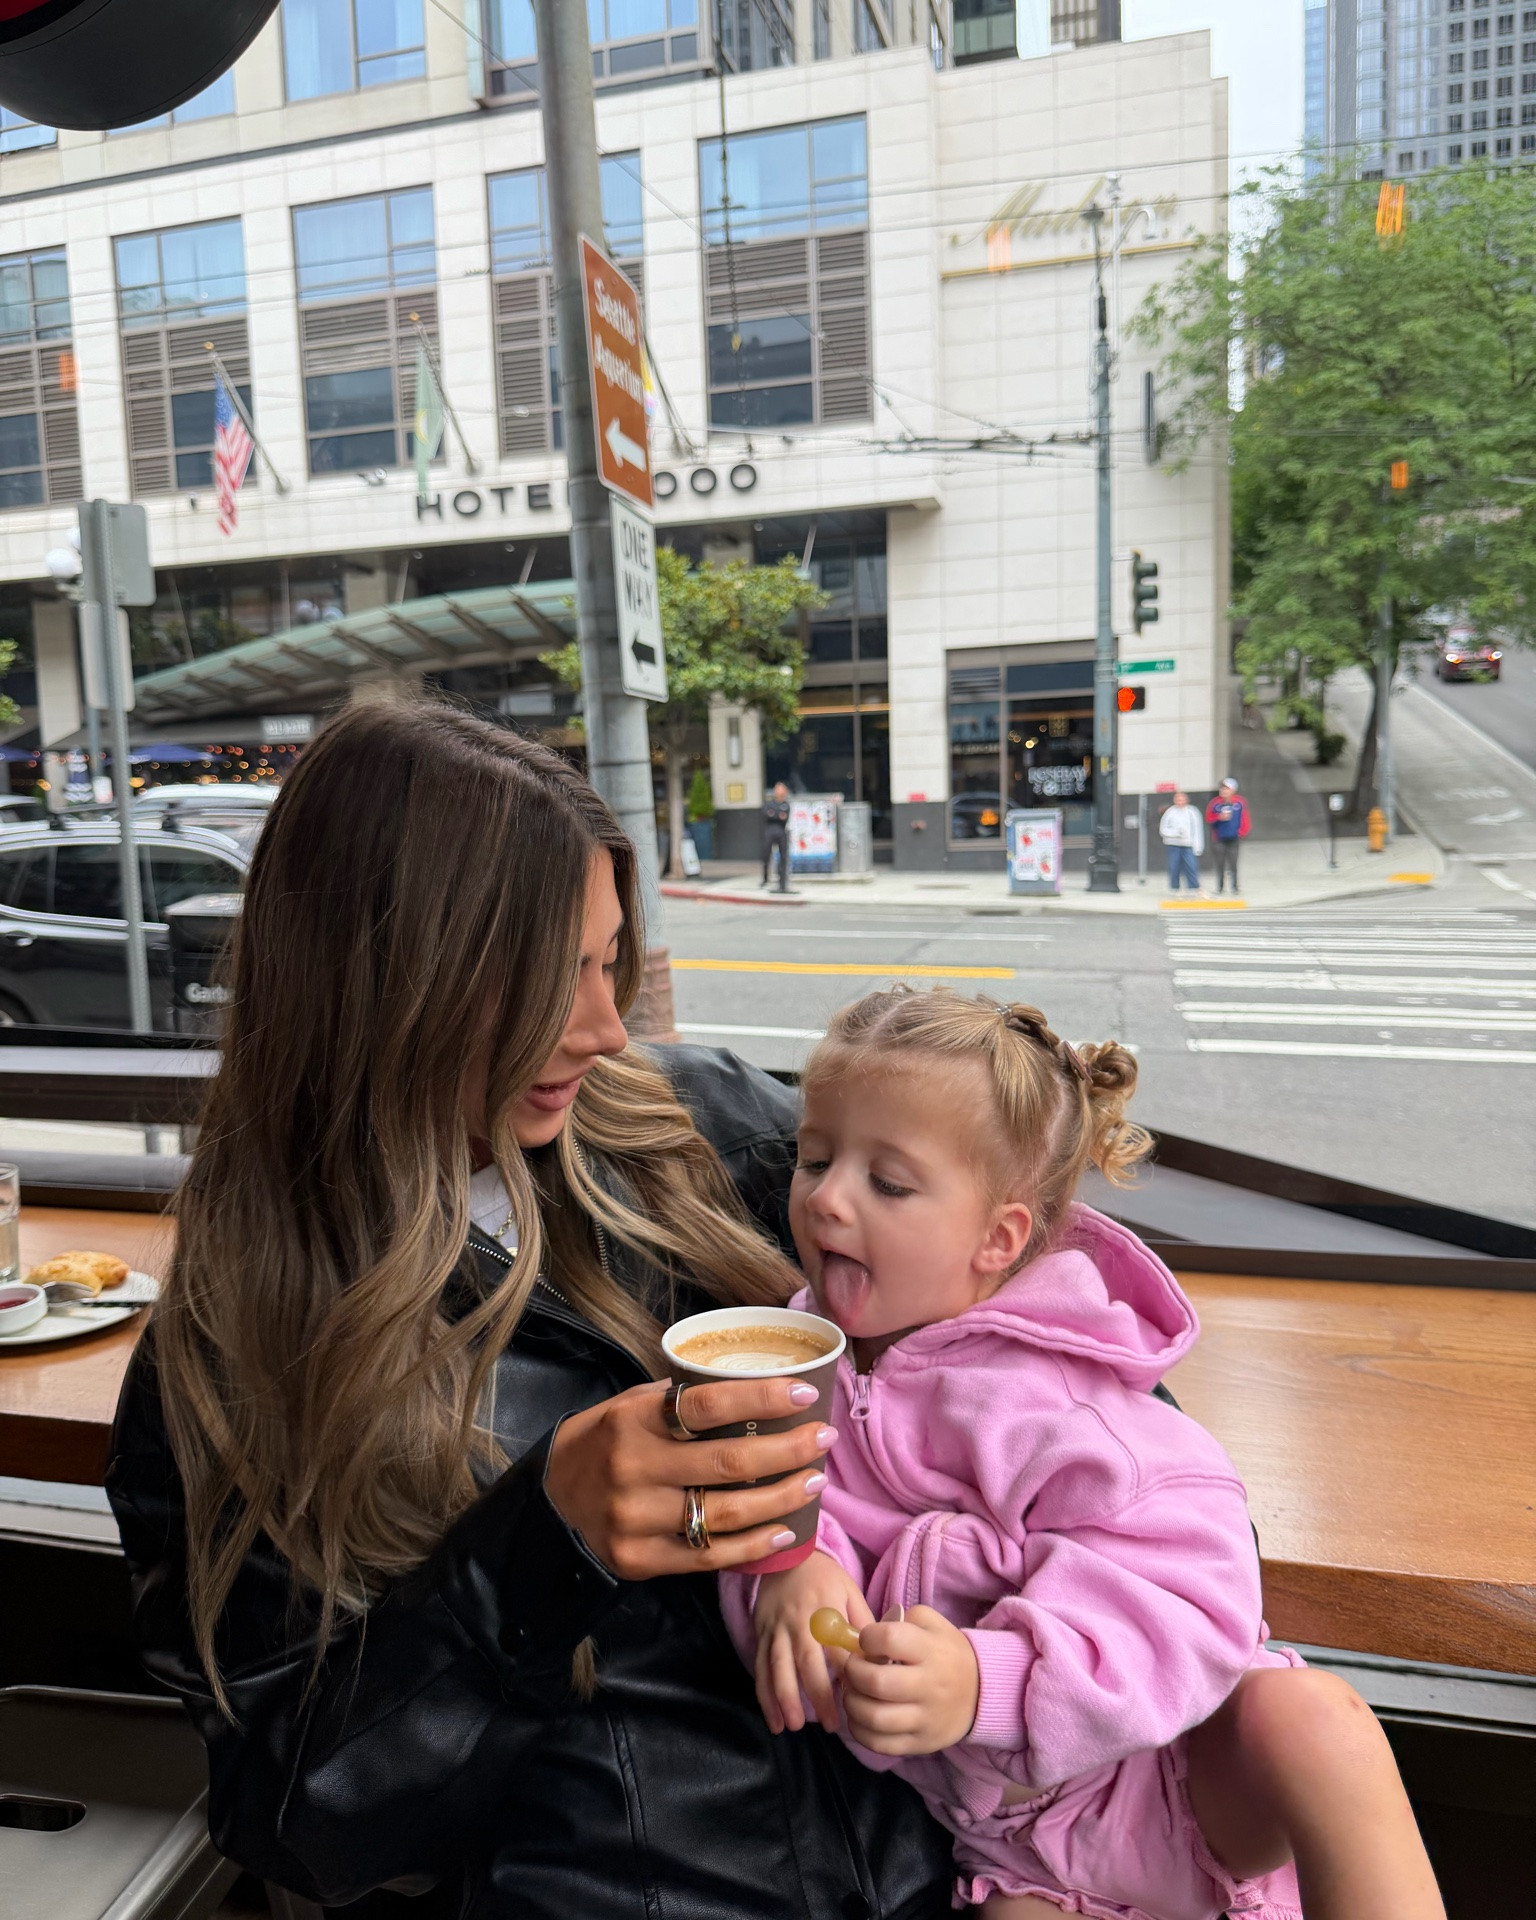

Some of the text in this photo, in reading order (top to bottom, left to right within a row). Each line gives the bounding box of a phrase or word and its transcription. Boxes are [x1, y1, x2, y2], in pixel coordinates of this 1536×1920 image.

[594, 277, 636, 346] Seattle
[416, 482, 570, 520] HOTE
[620, 519, 651, 571] ONE
